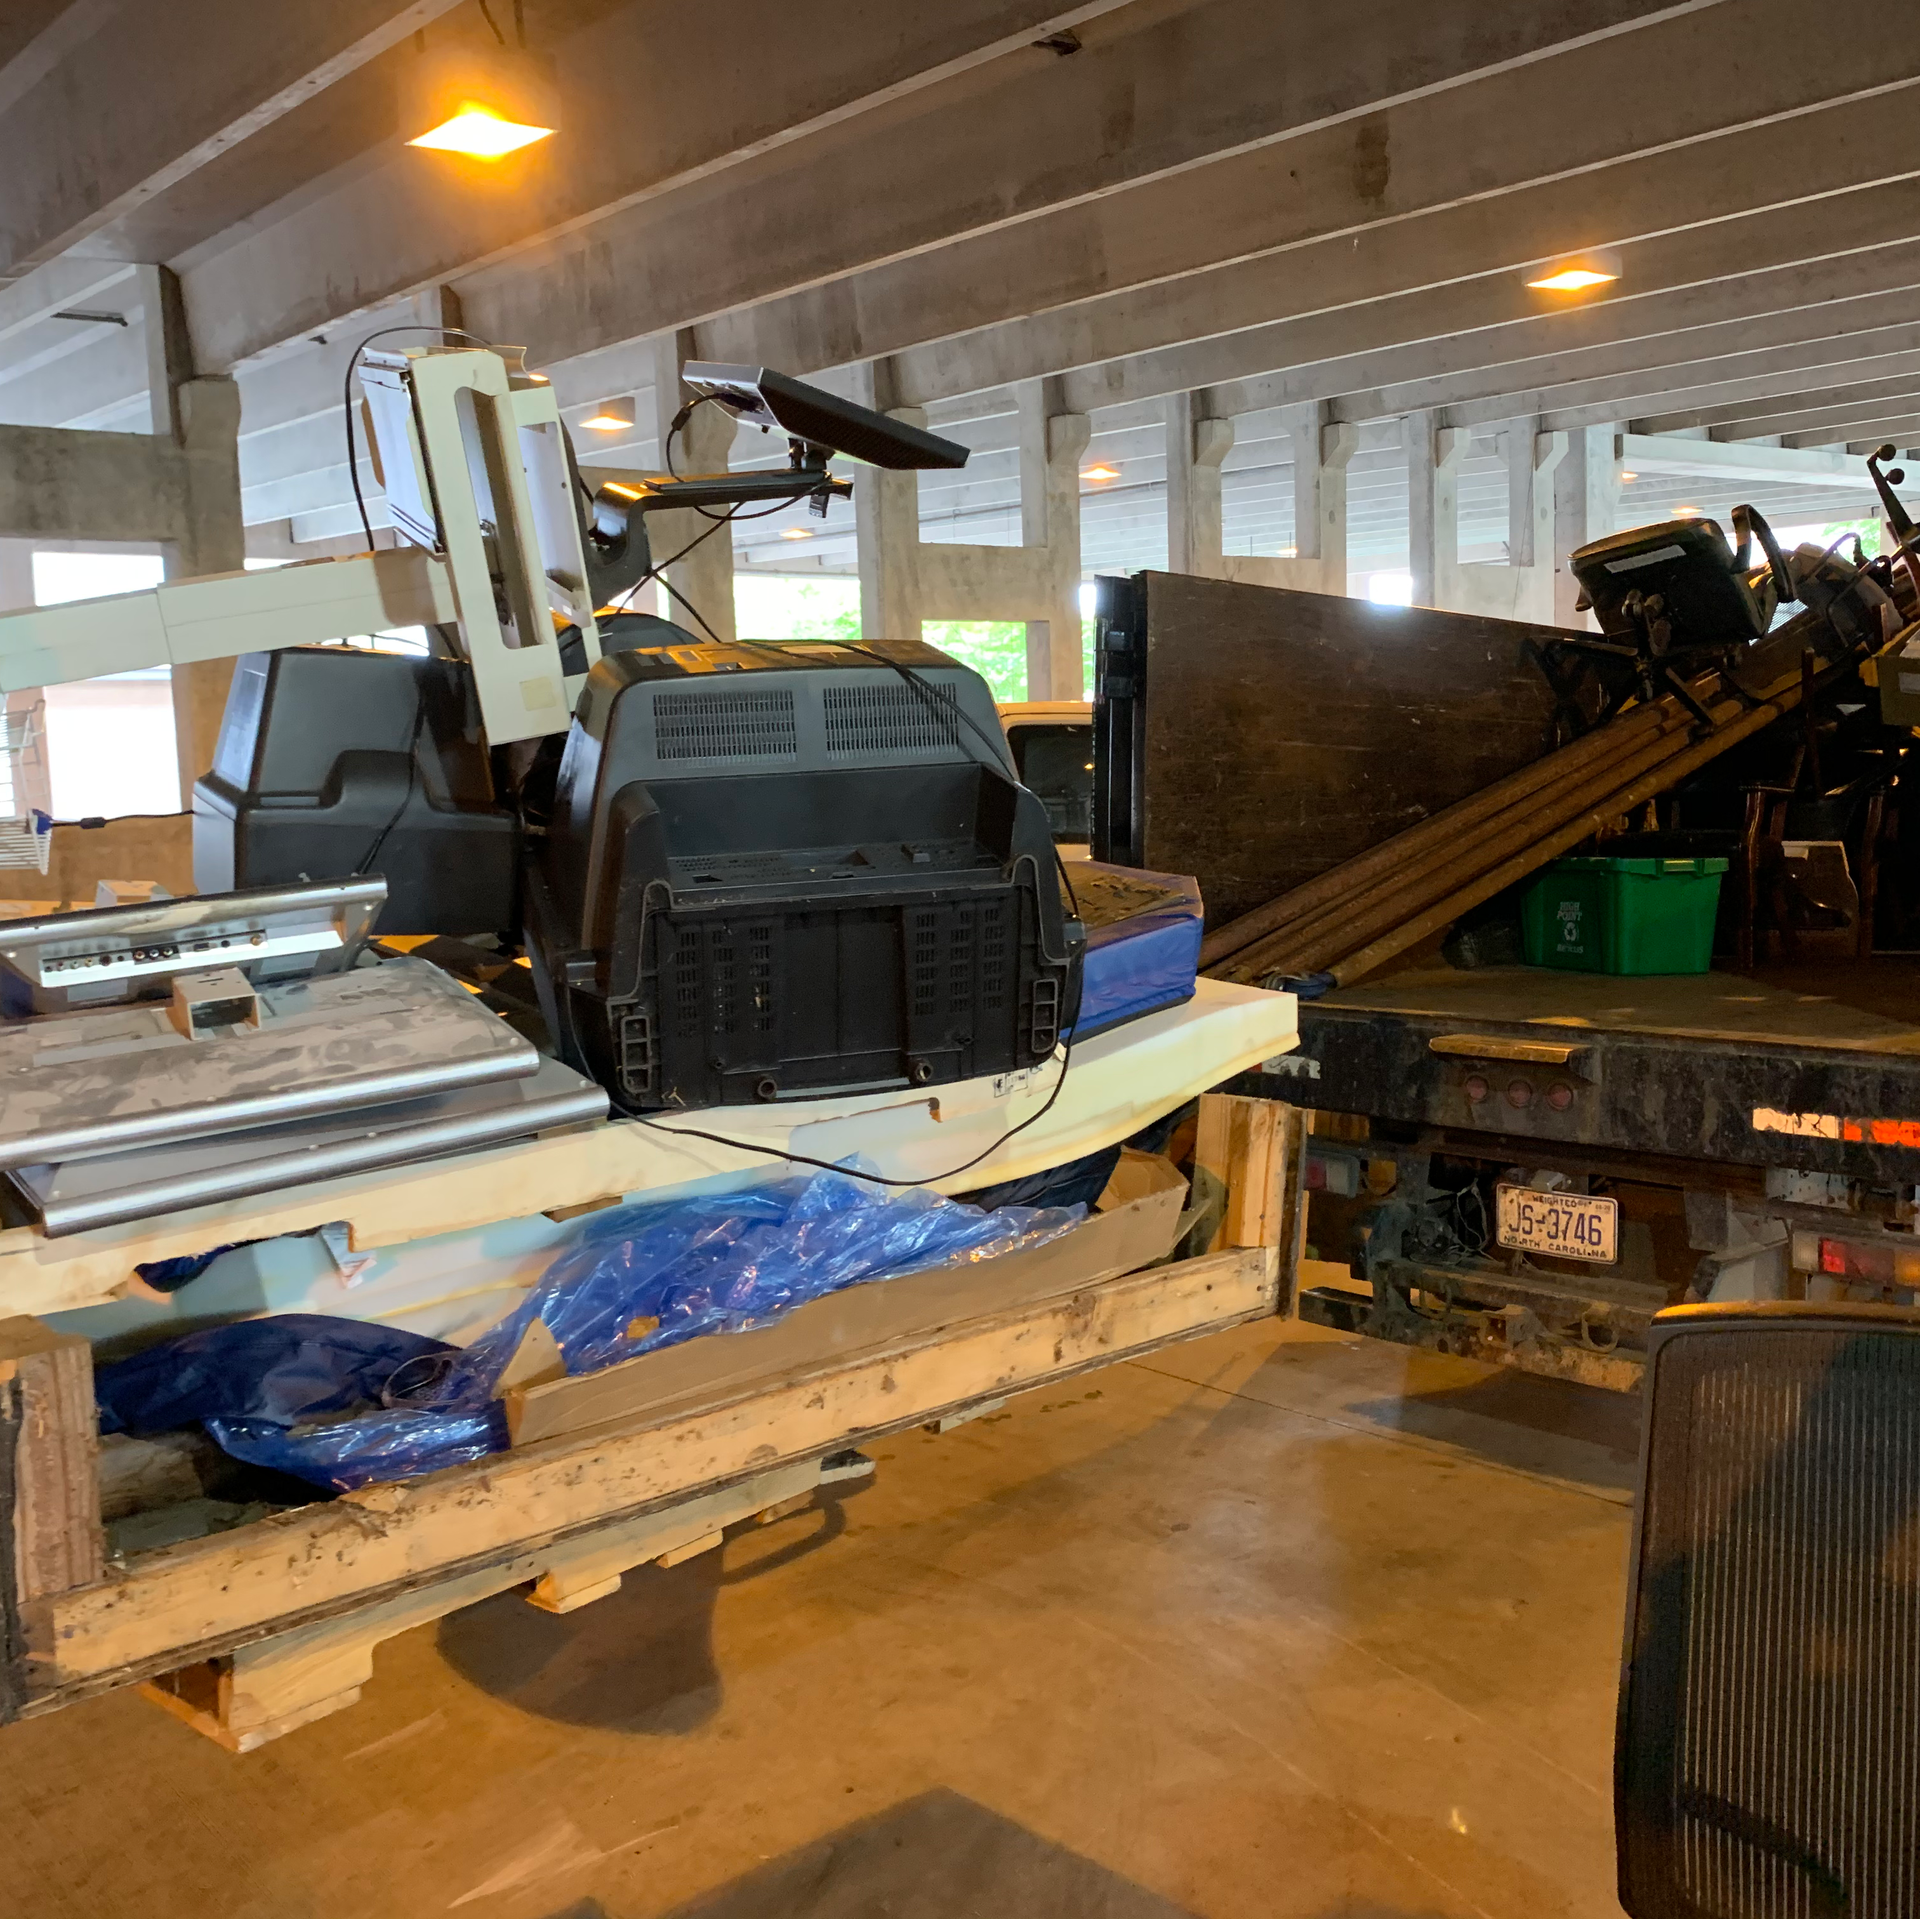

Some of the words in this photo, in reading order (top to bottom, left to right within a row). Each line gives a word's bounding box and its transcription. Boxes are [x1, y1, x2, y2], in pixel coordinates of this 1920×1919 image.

[1560, 901, 1580, 911] HIGH
[1557, 910, 1582, 921] POINT
[1504, 1235, 1540, 1247] NORTH
[1548, 1242, 1607, 1259] CAROLINA
